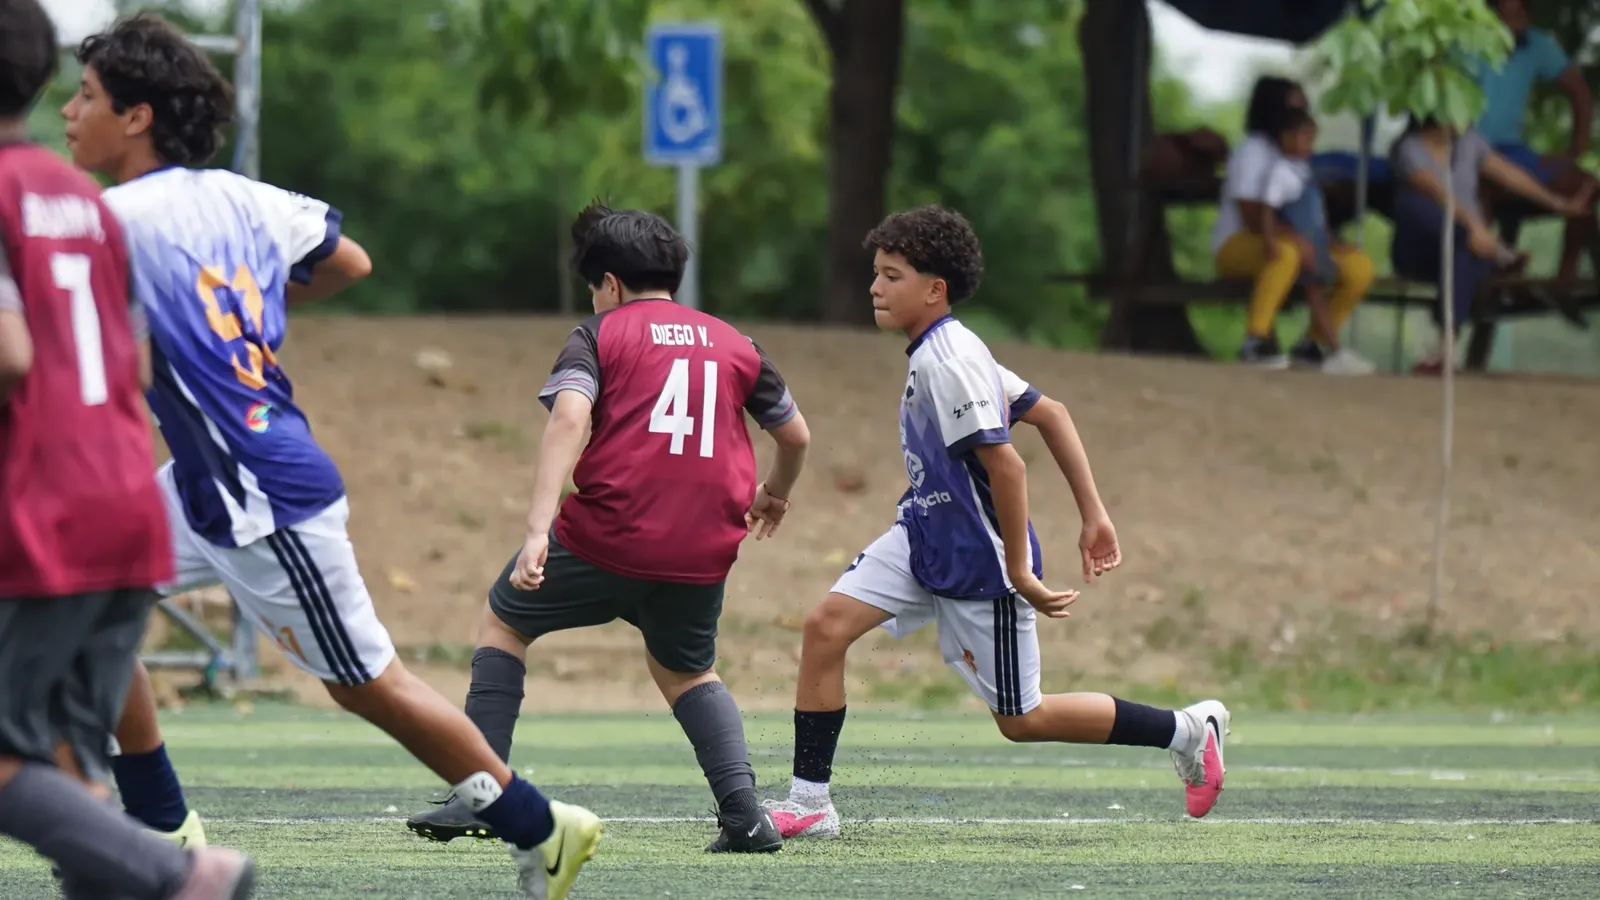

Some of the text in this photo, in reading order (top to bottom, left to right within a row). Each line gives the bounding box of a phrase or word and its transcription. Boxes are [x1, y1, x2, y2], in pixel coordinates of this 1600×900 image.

[649, 322, 714, 348] DIEGO V.
[648, 357, 718, 459] 41
